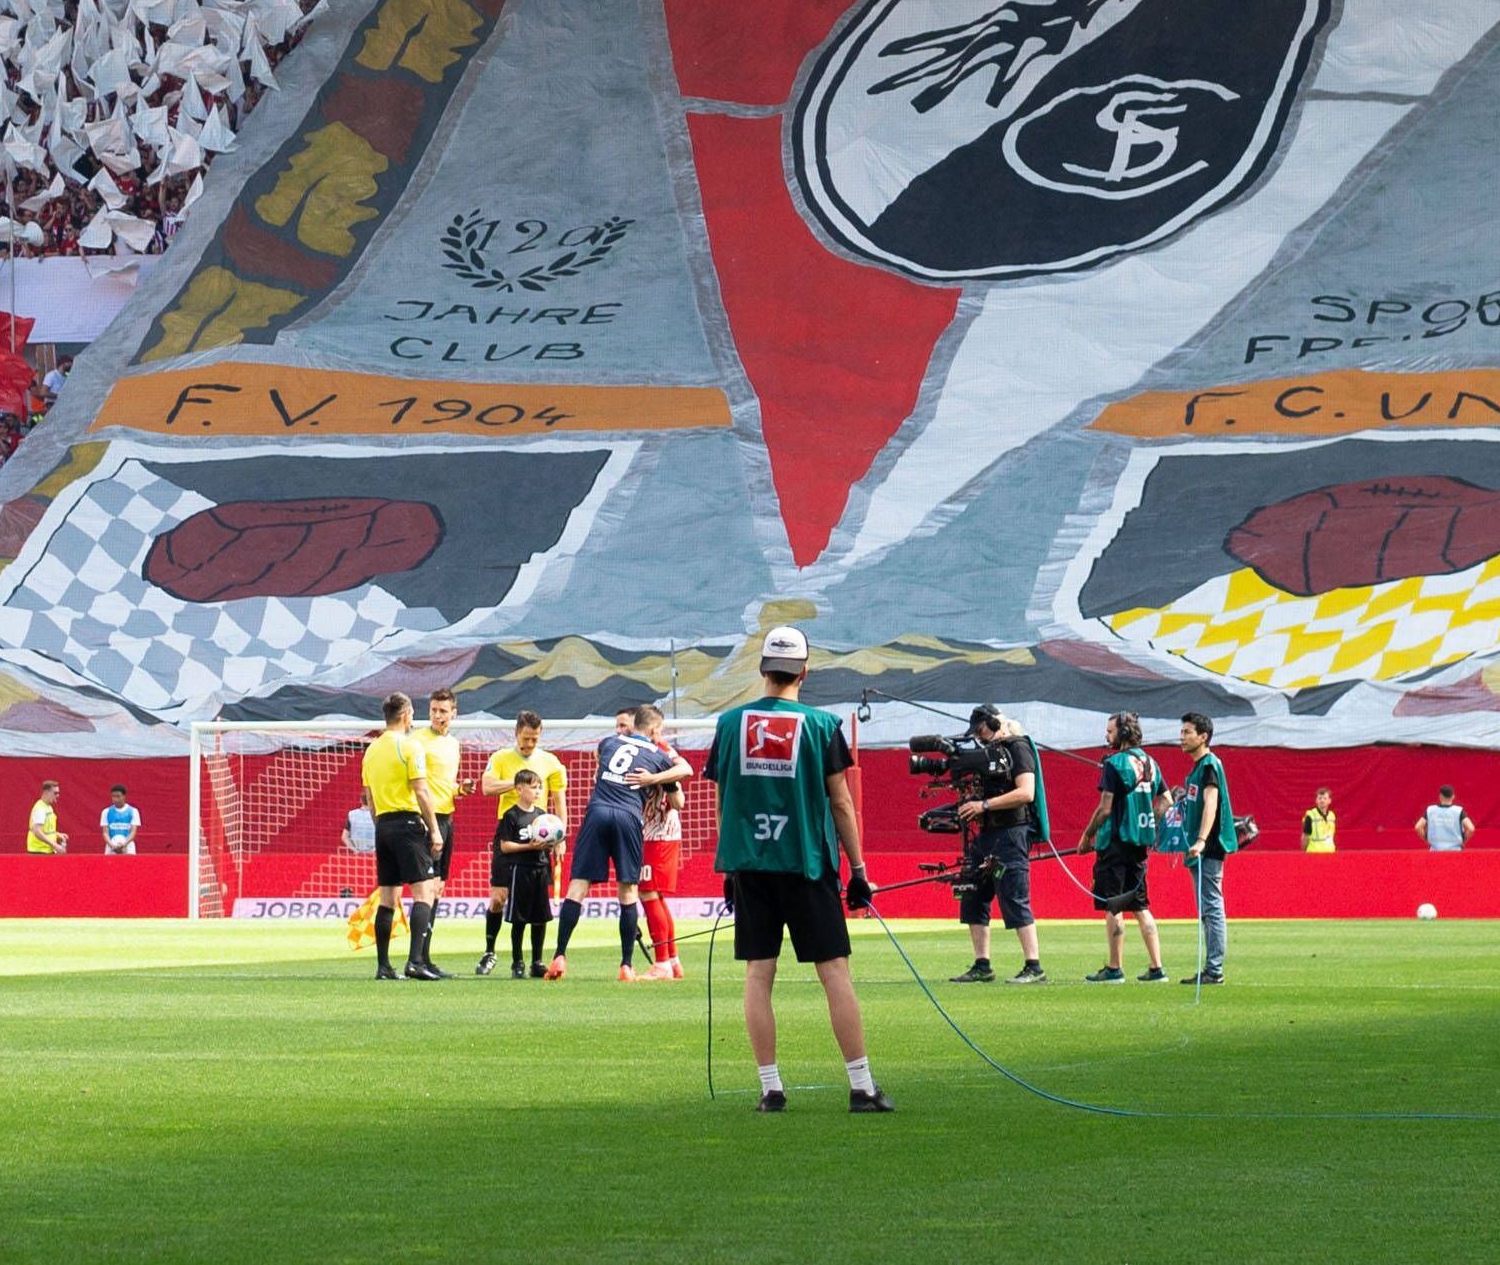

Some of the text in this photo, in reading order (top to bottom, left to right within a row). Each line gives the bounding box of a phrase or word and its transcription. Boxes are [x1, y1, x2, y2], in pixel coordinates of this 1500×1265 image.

[384, 300, 623, 326] JAHRE
[390, 336, 586, 362] CLUB
[378, 396, 576, 427] 1904
[608, 743, 639, 774] 6
[754, 813, 789, 841] 37
